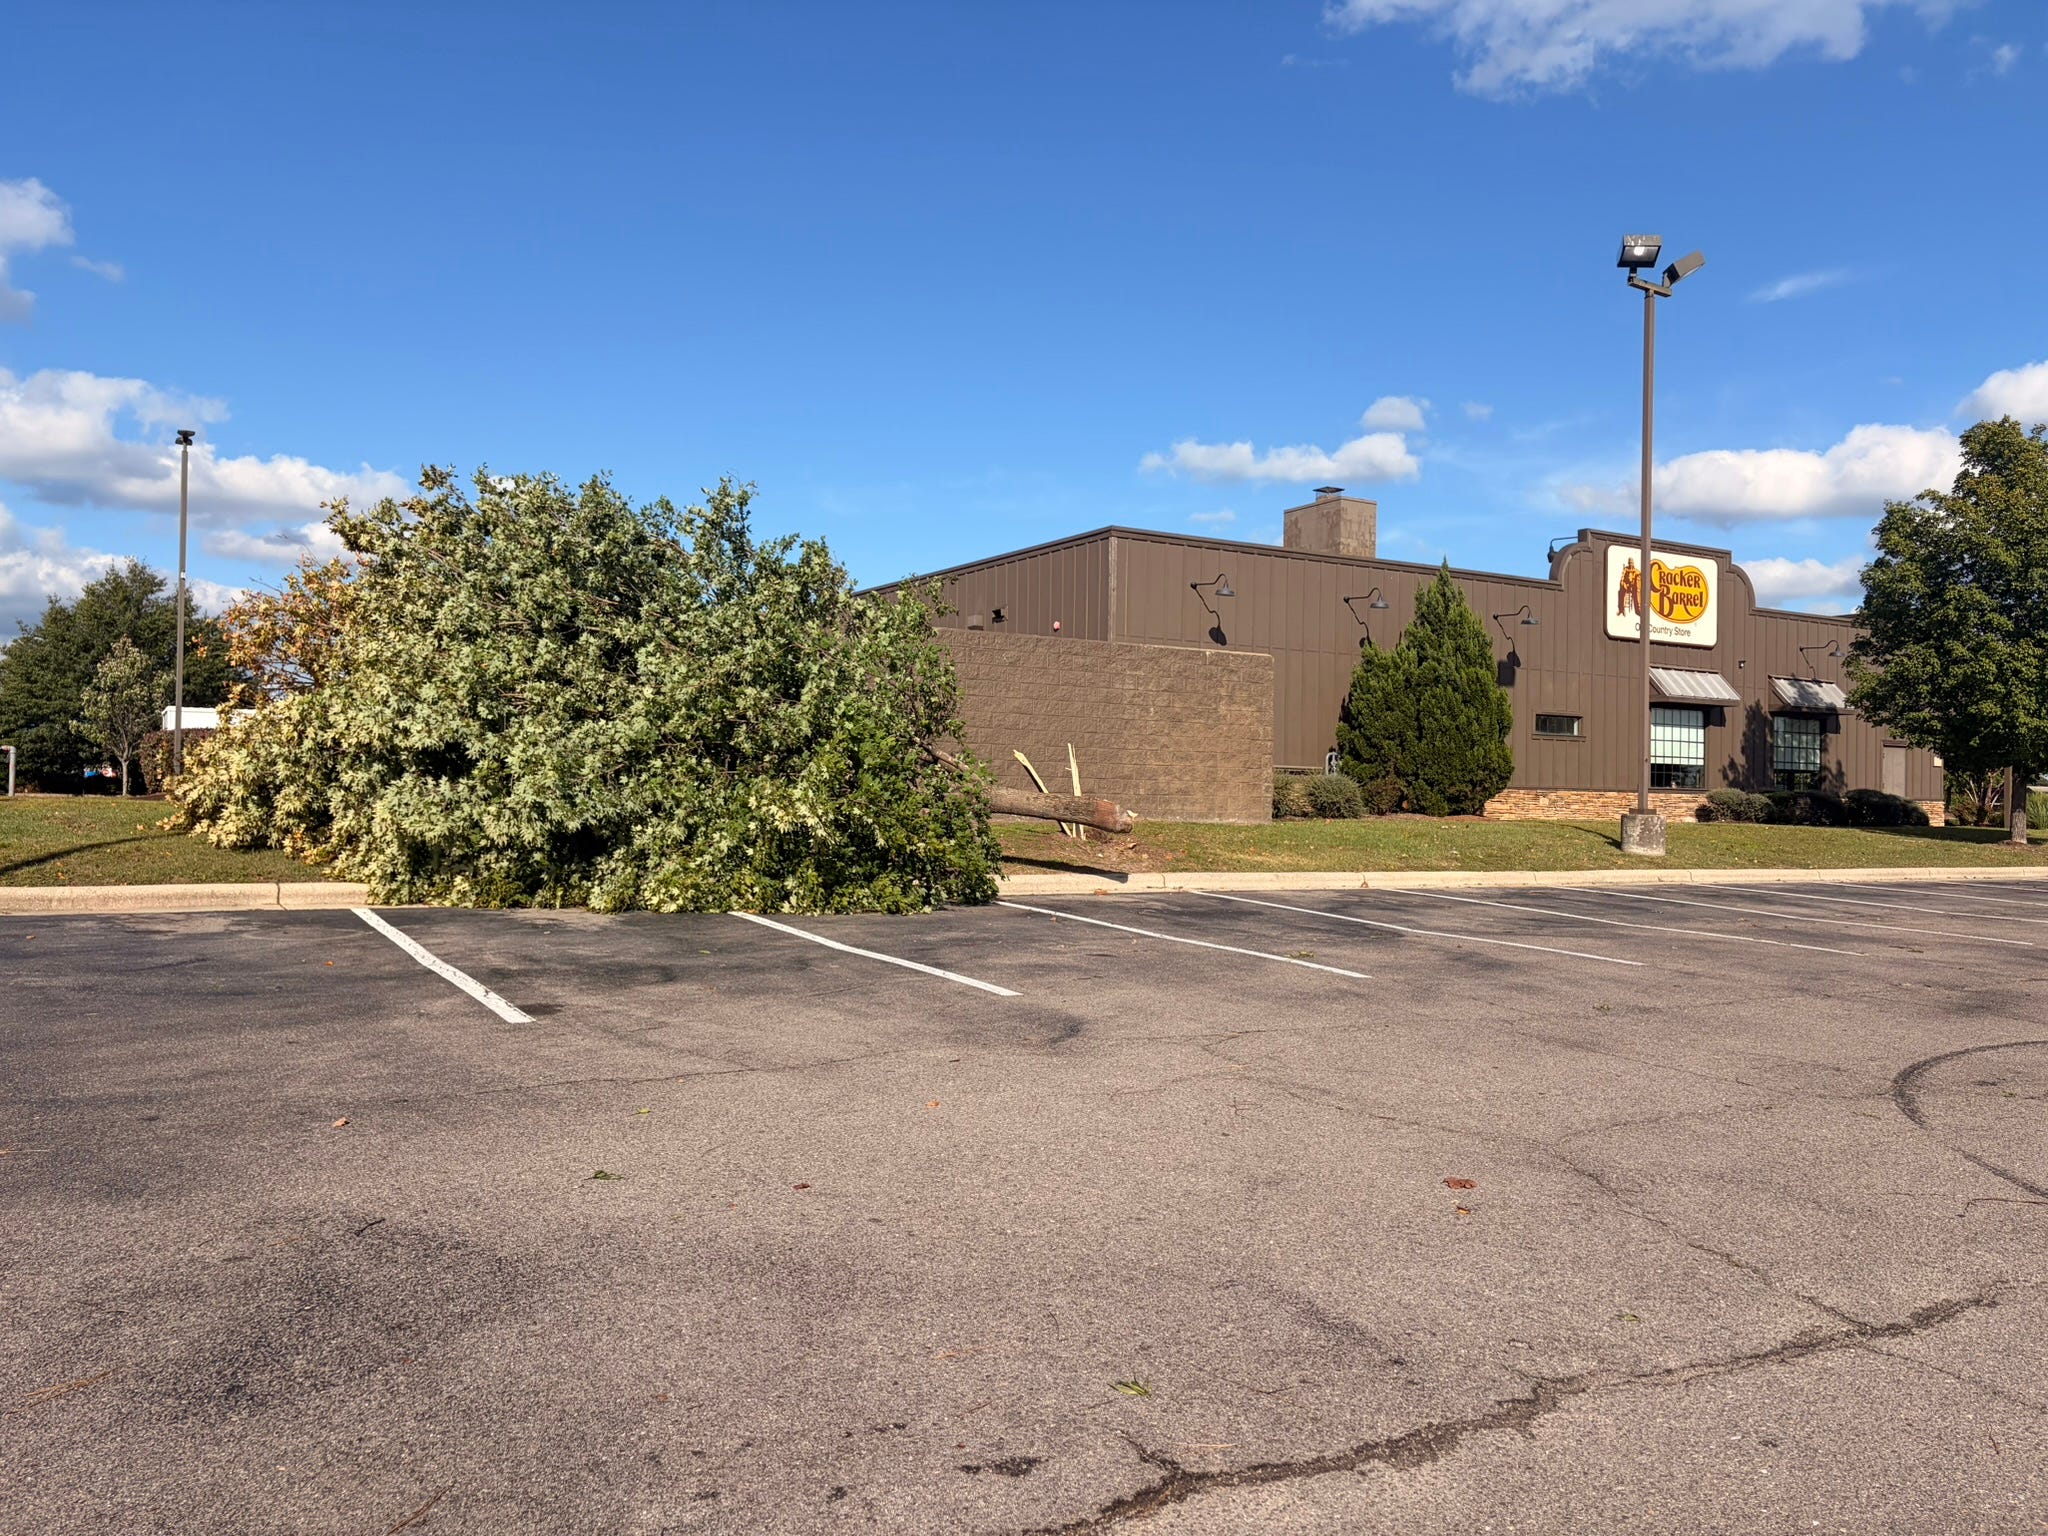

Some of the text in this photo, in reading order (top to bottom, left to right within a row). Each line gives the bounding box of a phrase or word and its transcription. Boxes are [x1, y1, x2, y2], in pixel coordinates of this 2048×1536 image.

[1650, 561, 1701, 593] Cracker
[1659, 585, 1704, 617] Barrel
[1650, 624, 1674, 637] Country
[1674, 626, 1691, 637] Store
